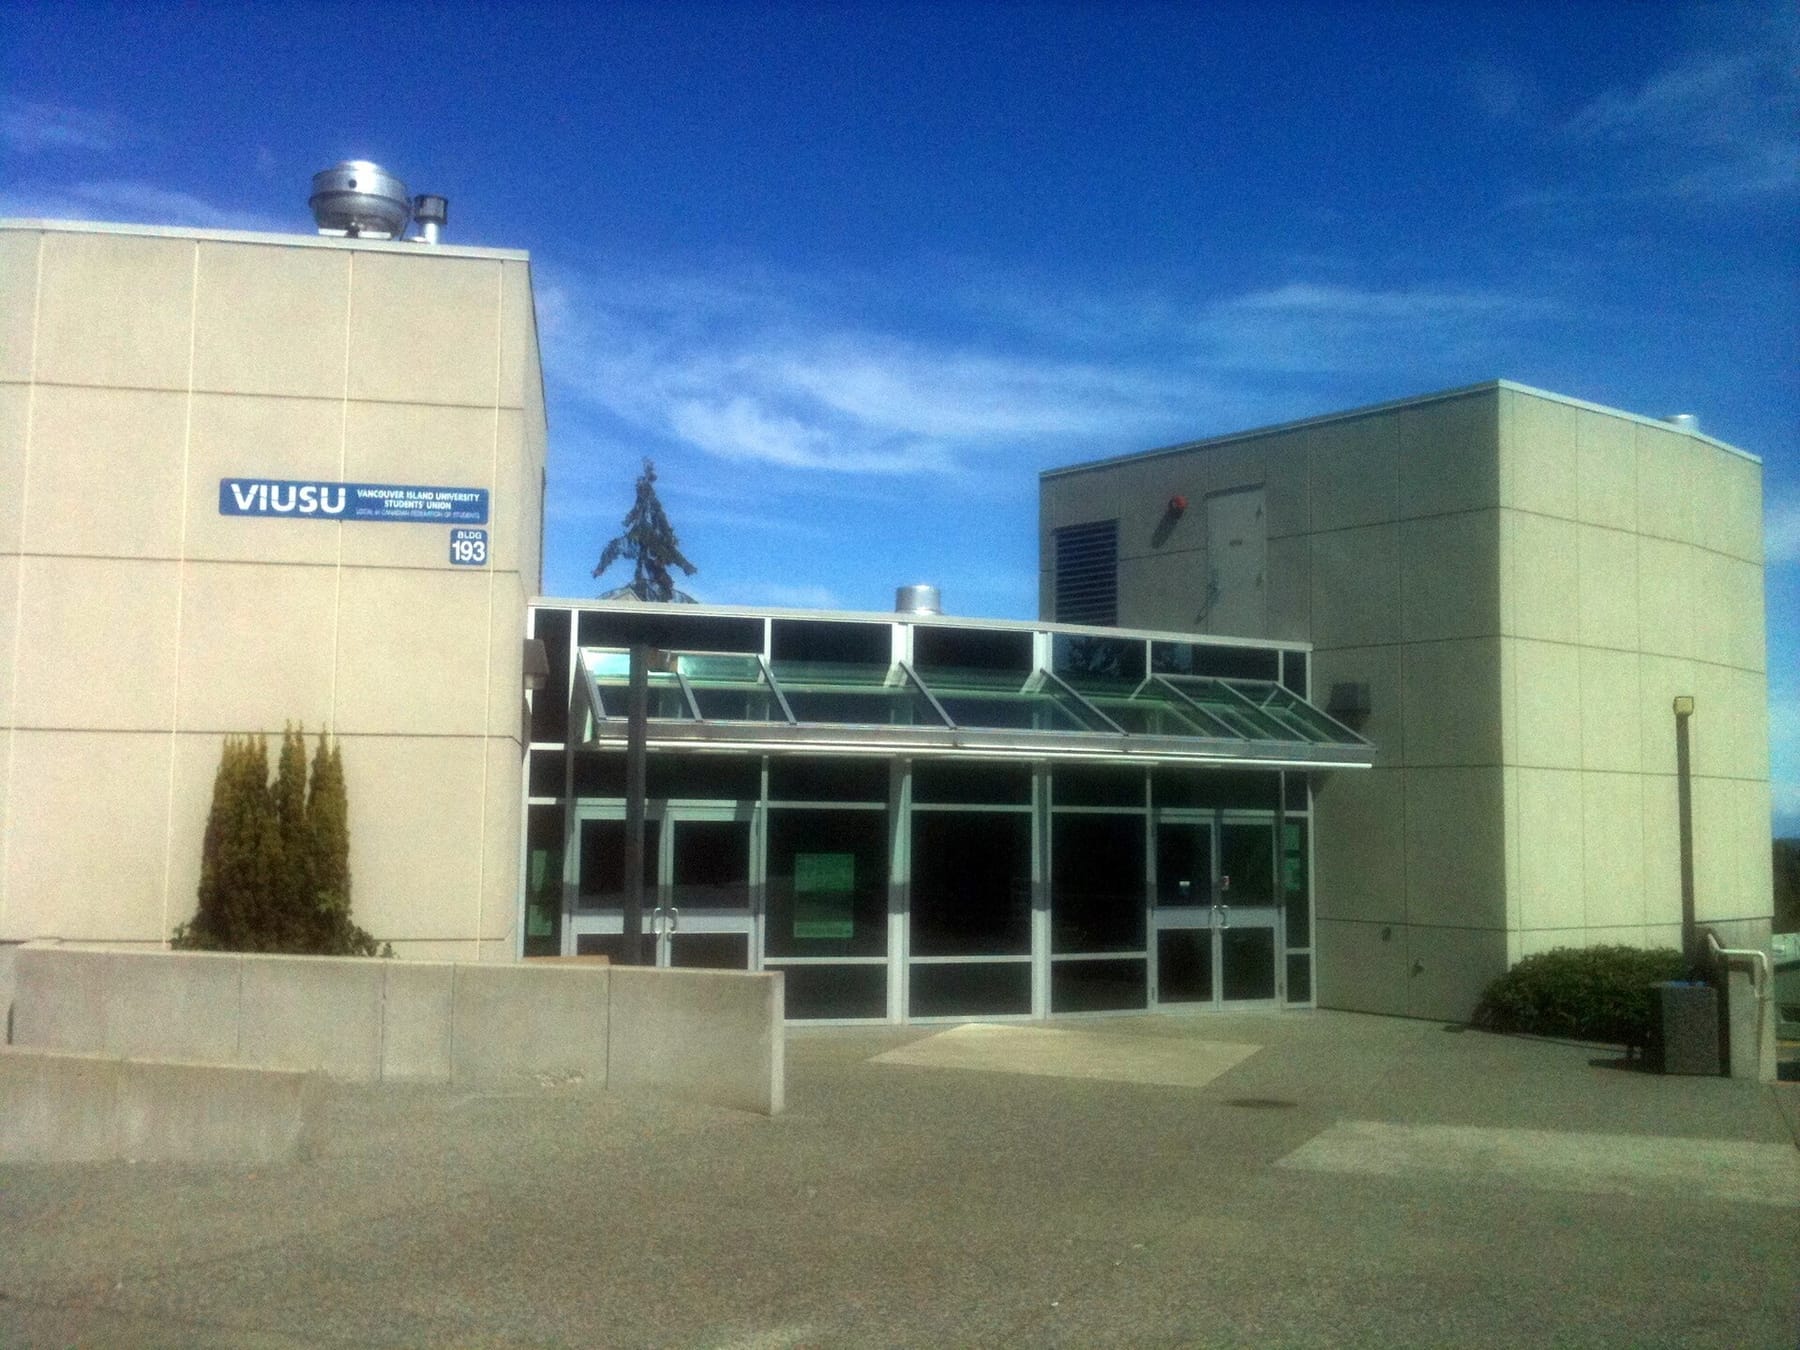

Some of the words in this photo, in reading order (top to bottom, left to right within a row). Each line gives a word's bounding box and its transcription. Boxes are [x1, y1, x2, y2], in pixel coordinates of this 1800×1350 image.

[230, 483, 346, 514] VIUSU
[357, 489, 404, 499] VANCOUVER
[406, 490, 434, 500] ISLAND
[435, 492, 480, 502] UNIVERSITY
[426, 501, 452, 510] UNION
[457, 531, 482, 540] BLDG
[452, 541, 486, 562] 193
